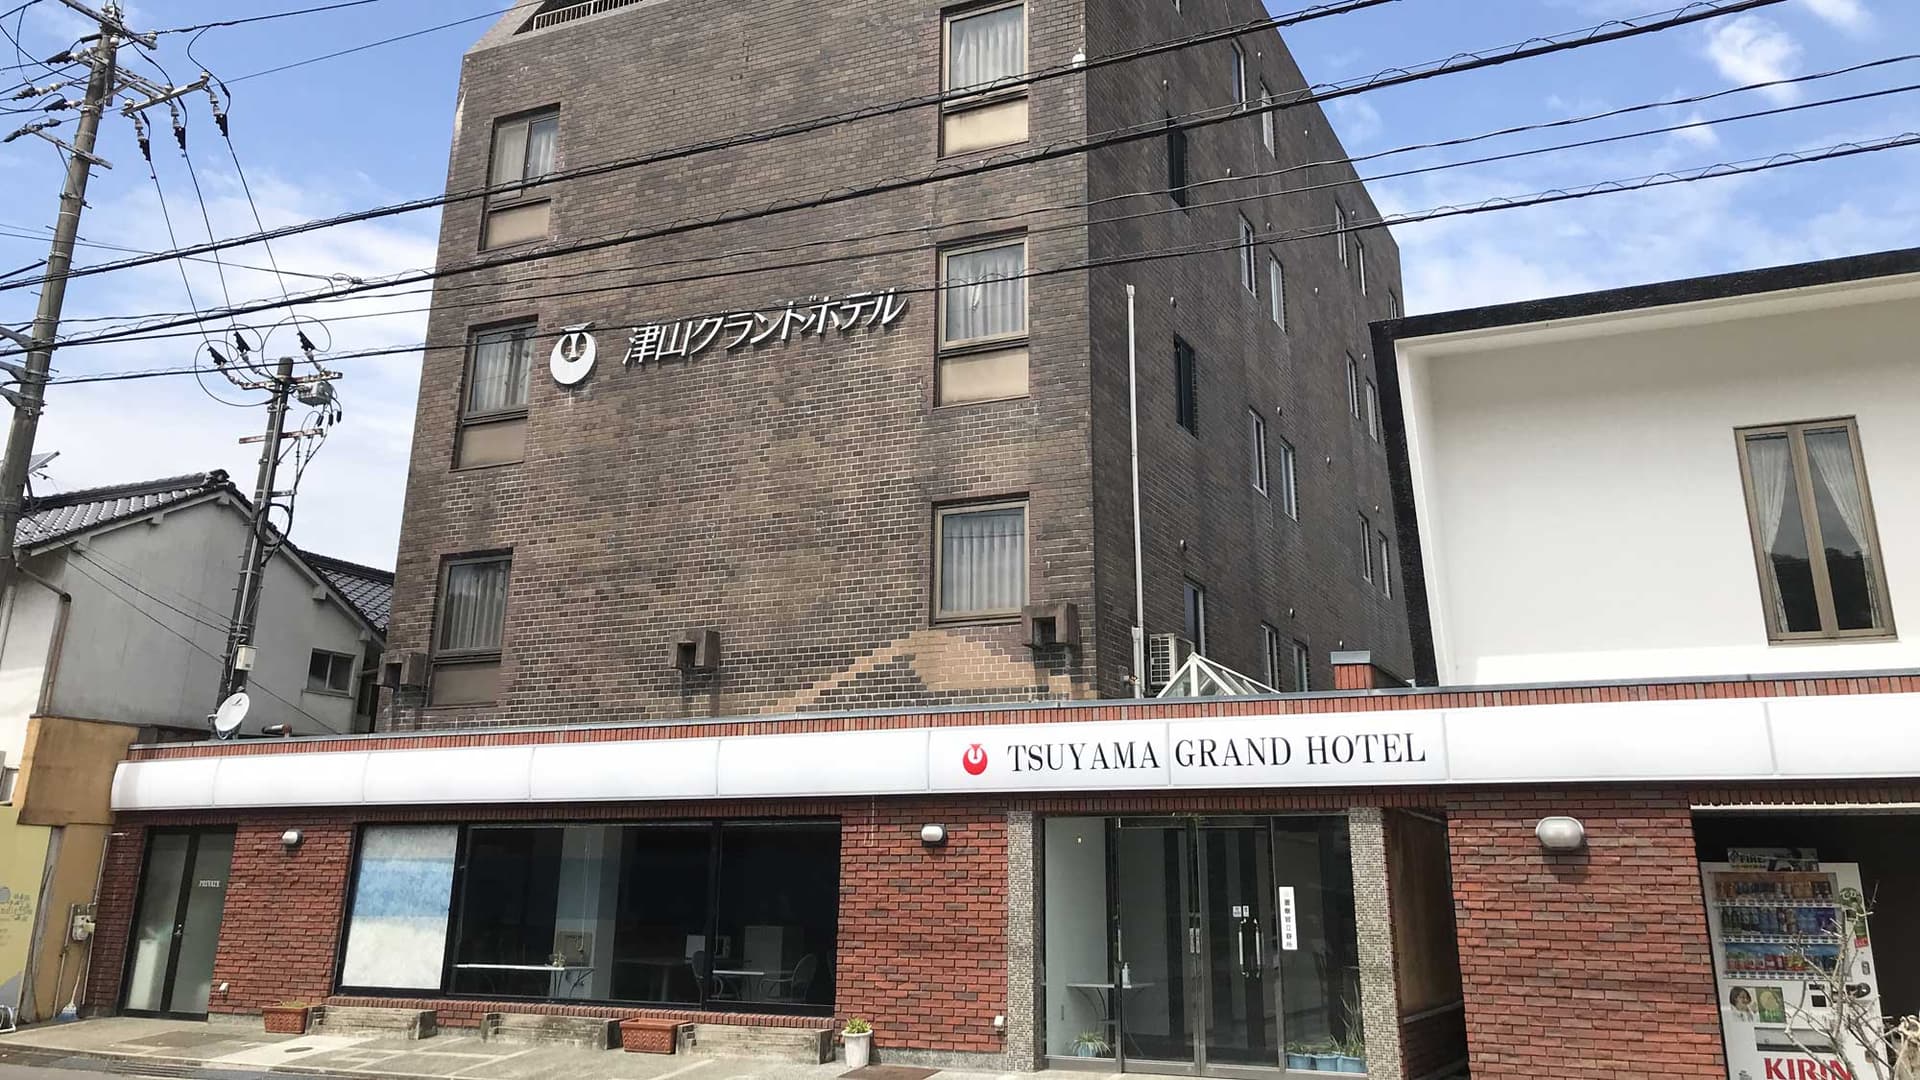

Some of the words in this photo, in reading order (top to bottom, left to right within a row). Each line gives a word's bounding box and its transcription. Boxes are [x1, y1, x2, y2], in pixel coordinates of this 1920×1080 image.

[622, 287, 908, 366] 津山グランドホテル
[1007, 740, 1161, 773] TSUYAMA
[1174, 735, 1293, 768] GRAND
[1305, 732, 1427, 765] HOTEL
